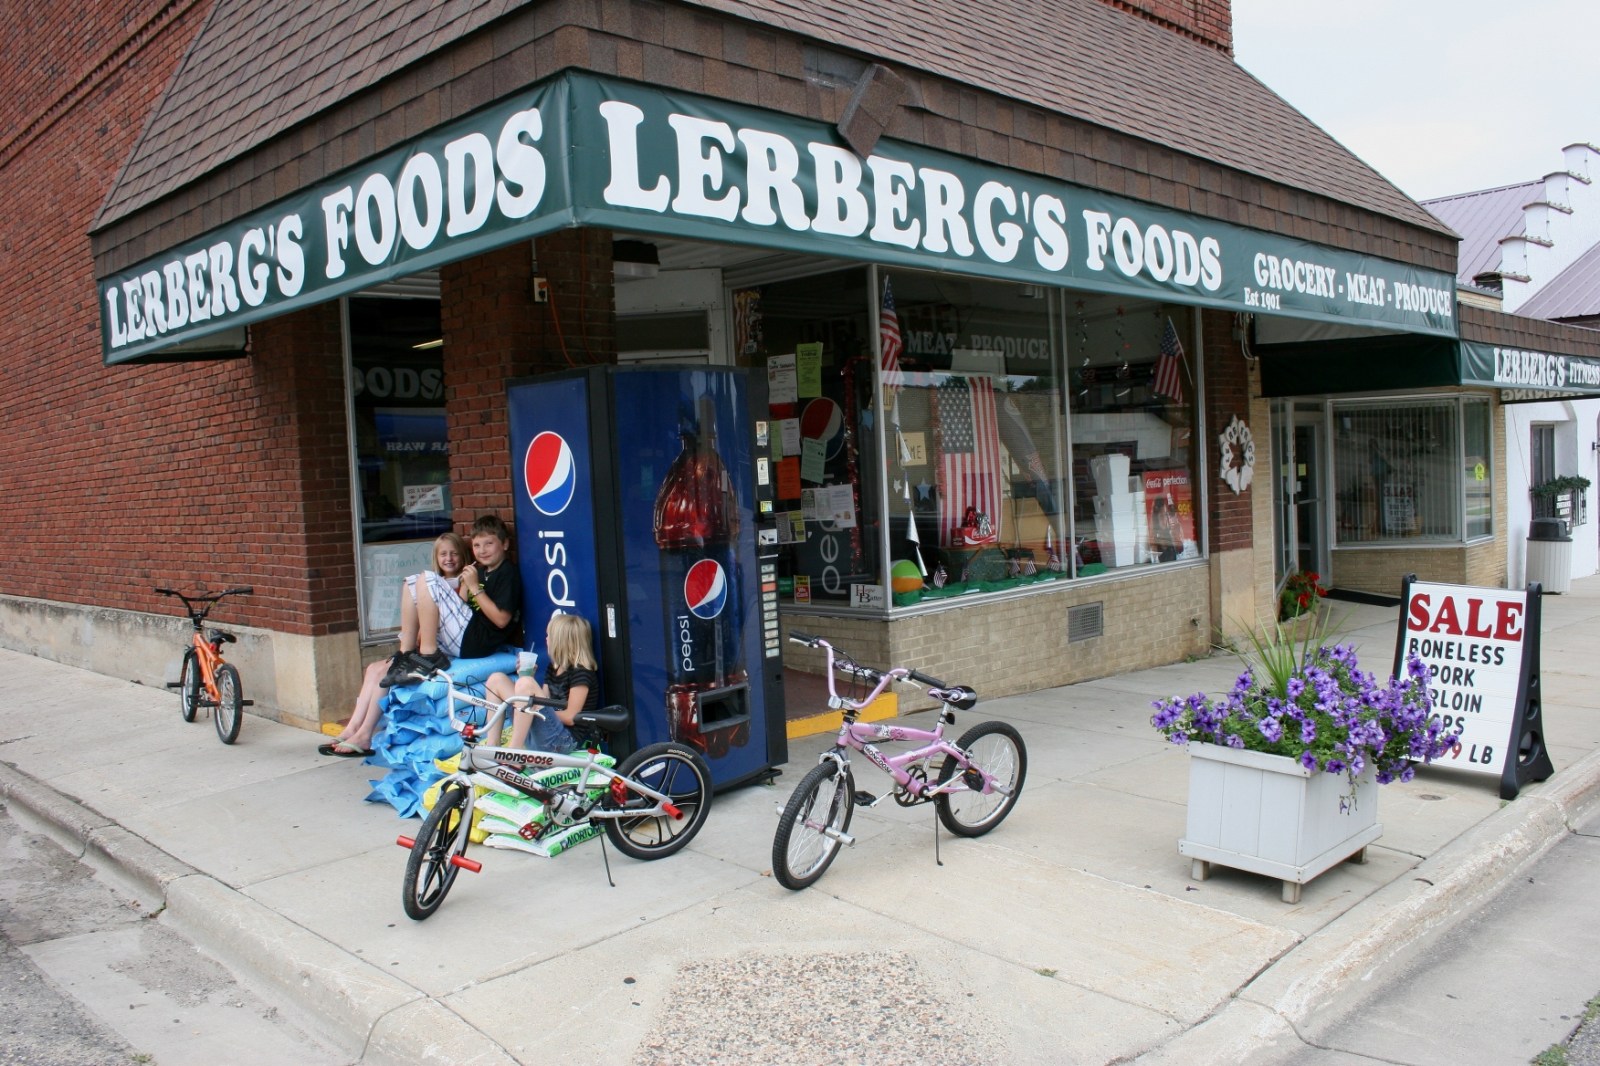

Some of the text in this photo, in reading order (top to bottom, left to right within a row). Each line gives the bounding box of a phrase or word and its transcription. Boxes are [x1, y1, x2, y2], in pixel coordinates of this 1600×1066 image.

[599, 100, 1222, 291] LERBERG'S FOODS
[106, 107, 547, 349] LERBERG'S FOODS
[1243, 287, 1281, 310] Est 1901
[1253, 252, 1452, 317] GROCERY MEAT PRODUCE
[1493, 347, 1600, 388] LERBERG'S FITNESS
[1407, 592, 1524, 642] SALE
[676, 614, 696, 672] pepsi
[1409, 637, 1505, 666] BONELESS
[1429, 663, 1475, 688] PORK
[494, 750, 554, 766] mongoose
[863, 745, 893, 774] MONGOOSE
[1469, 743, 1494, 765] LB
[540, 767, 581, 788] MORTON
[566, 826, 601, 847] MORTON
